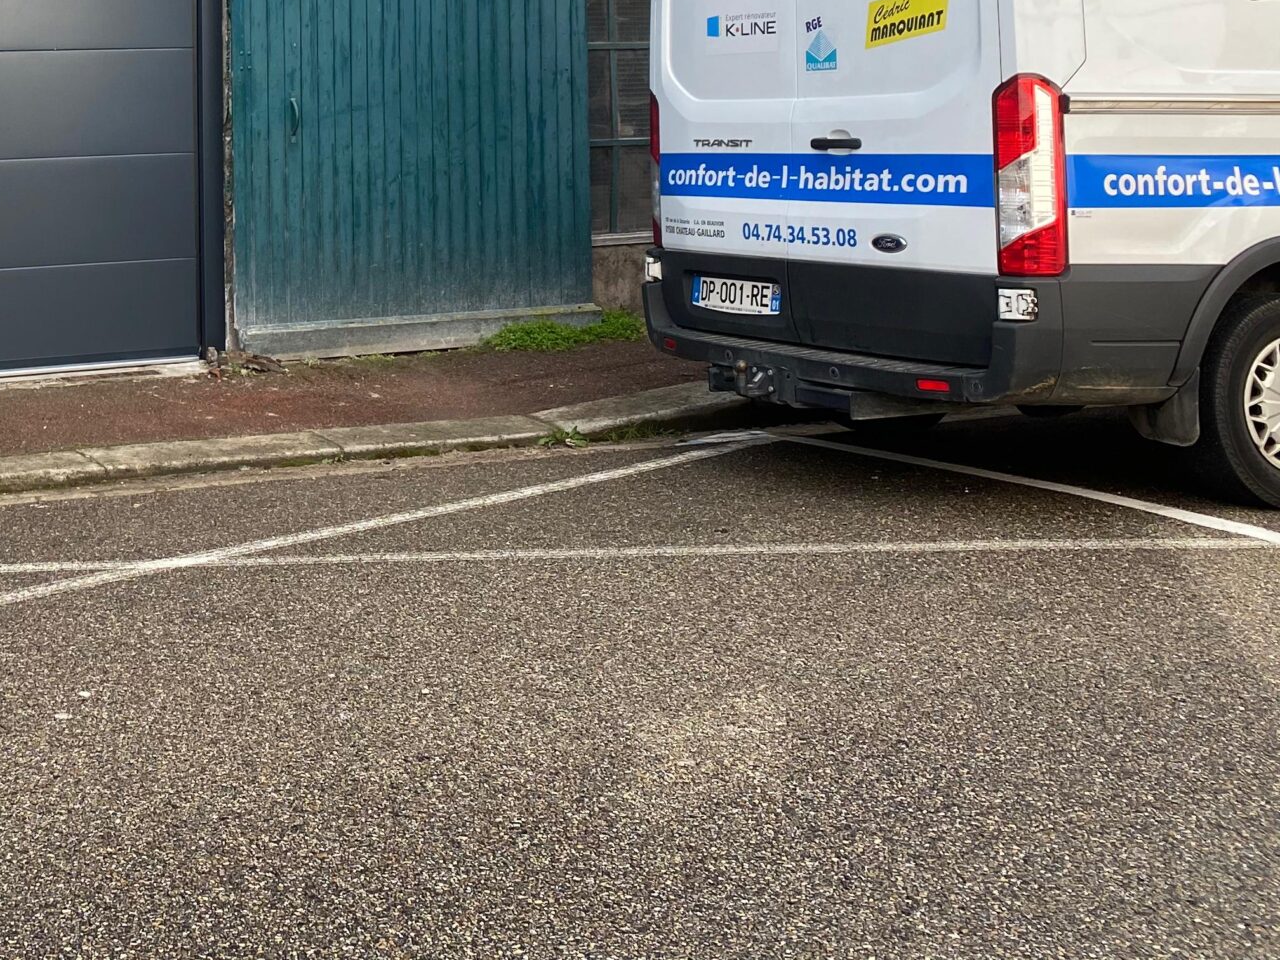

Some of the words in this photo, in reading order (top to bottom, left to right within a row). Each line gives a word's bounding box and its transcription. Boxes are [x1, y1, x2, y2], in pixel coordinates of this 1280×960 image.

[805, 16, 823, 33] RGE
[870, 10, 944, 42] MARQUIANT
[693, 139, 753, 148] TRANSIT
[668, 163, 968, 193] confort-de-l-habitat.com
[742, 222, 857, 247] 04.74.34.53.08
